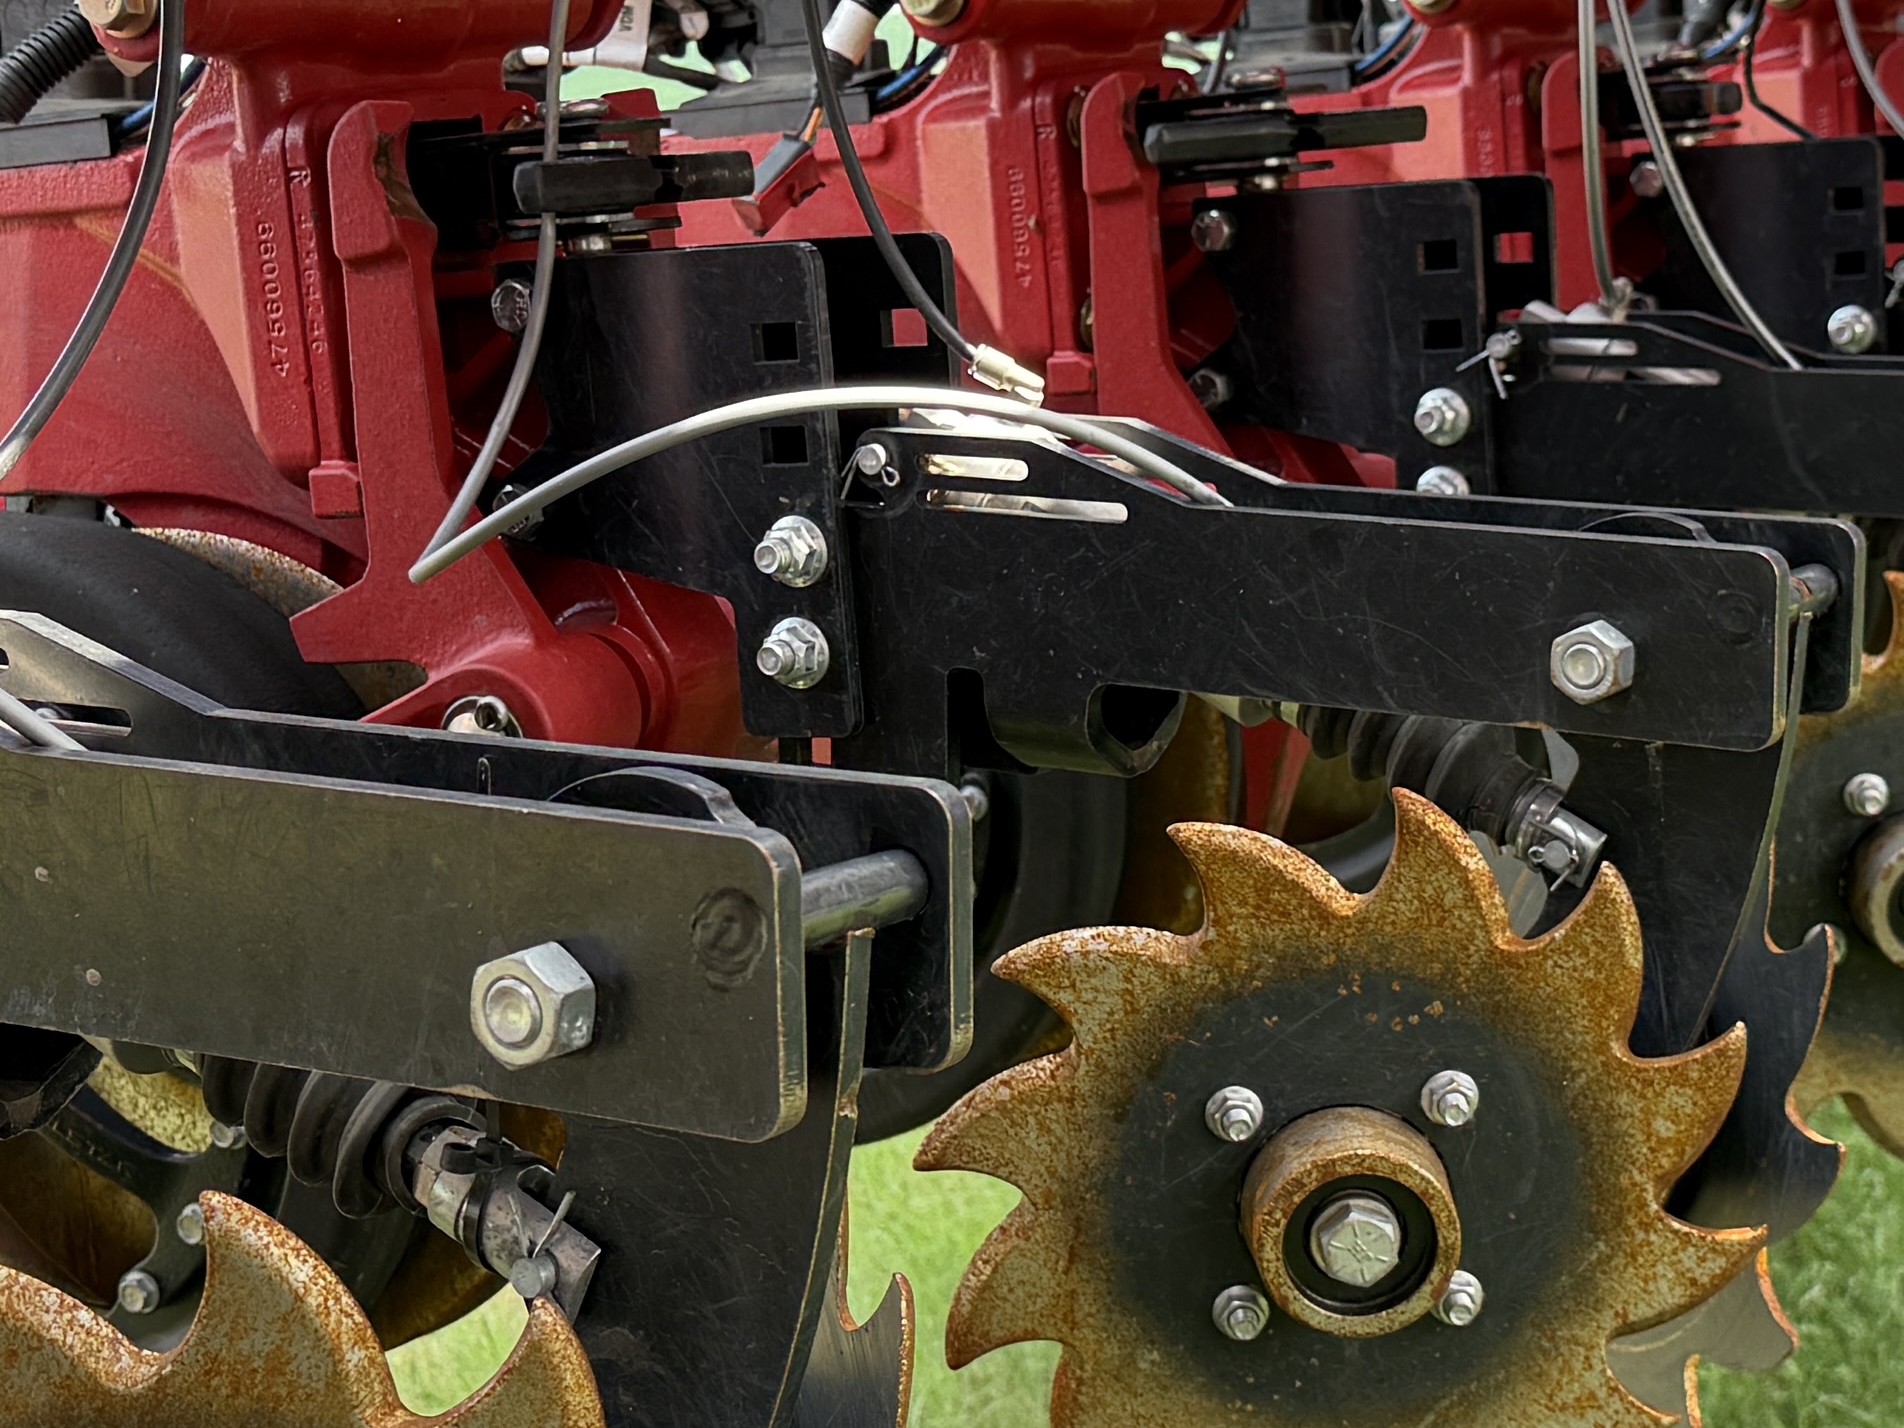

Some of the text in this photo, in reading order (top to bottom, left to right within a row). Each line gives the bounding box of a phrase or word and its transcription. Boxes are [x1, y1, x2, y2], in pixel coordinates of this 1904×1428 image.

[619, 5, 634, 32] VDM
[289, 169, 311, 188] R
[258, 222, 290, 378] 47560099
